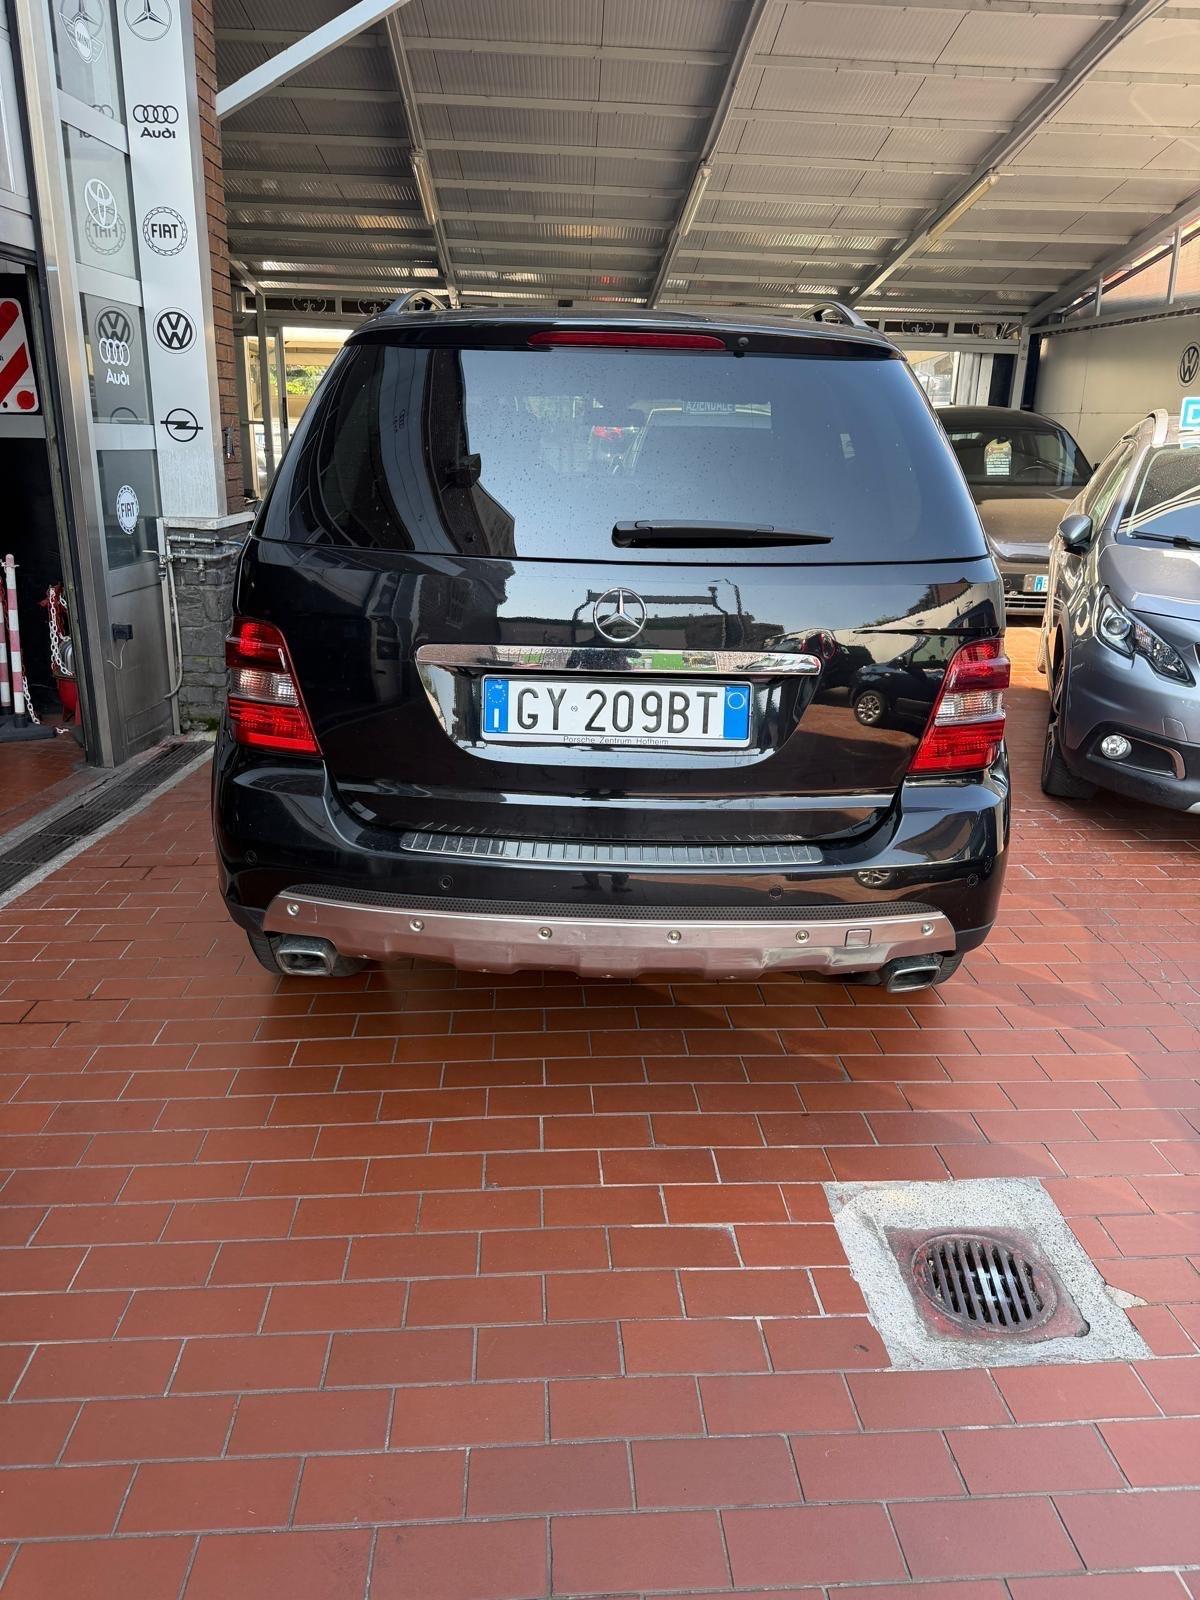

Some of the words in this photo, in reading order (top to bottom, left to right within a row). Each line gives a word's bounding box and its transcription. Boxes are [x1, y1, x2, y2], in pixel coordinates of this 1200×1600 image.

[140, 127, 176, 139] Audi
[151, 223, 179, 239] FIAT
[106, 369, 130, 385] Audi
[120, 503, 135, 518] FIAT
[517, 687, 567, 731] GY
[584, 688, 718, 735] 209BT
[563, 735, 596, 744] Porsche
[599, 736, 632, 745] Zentrum
